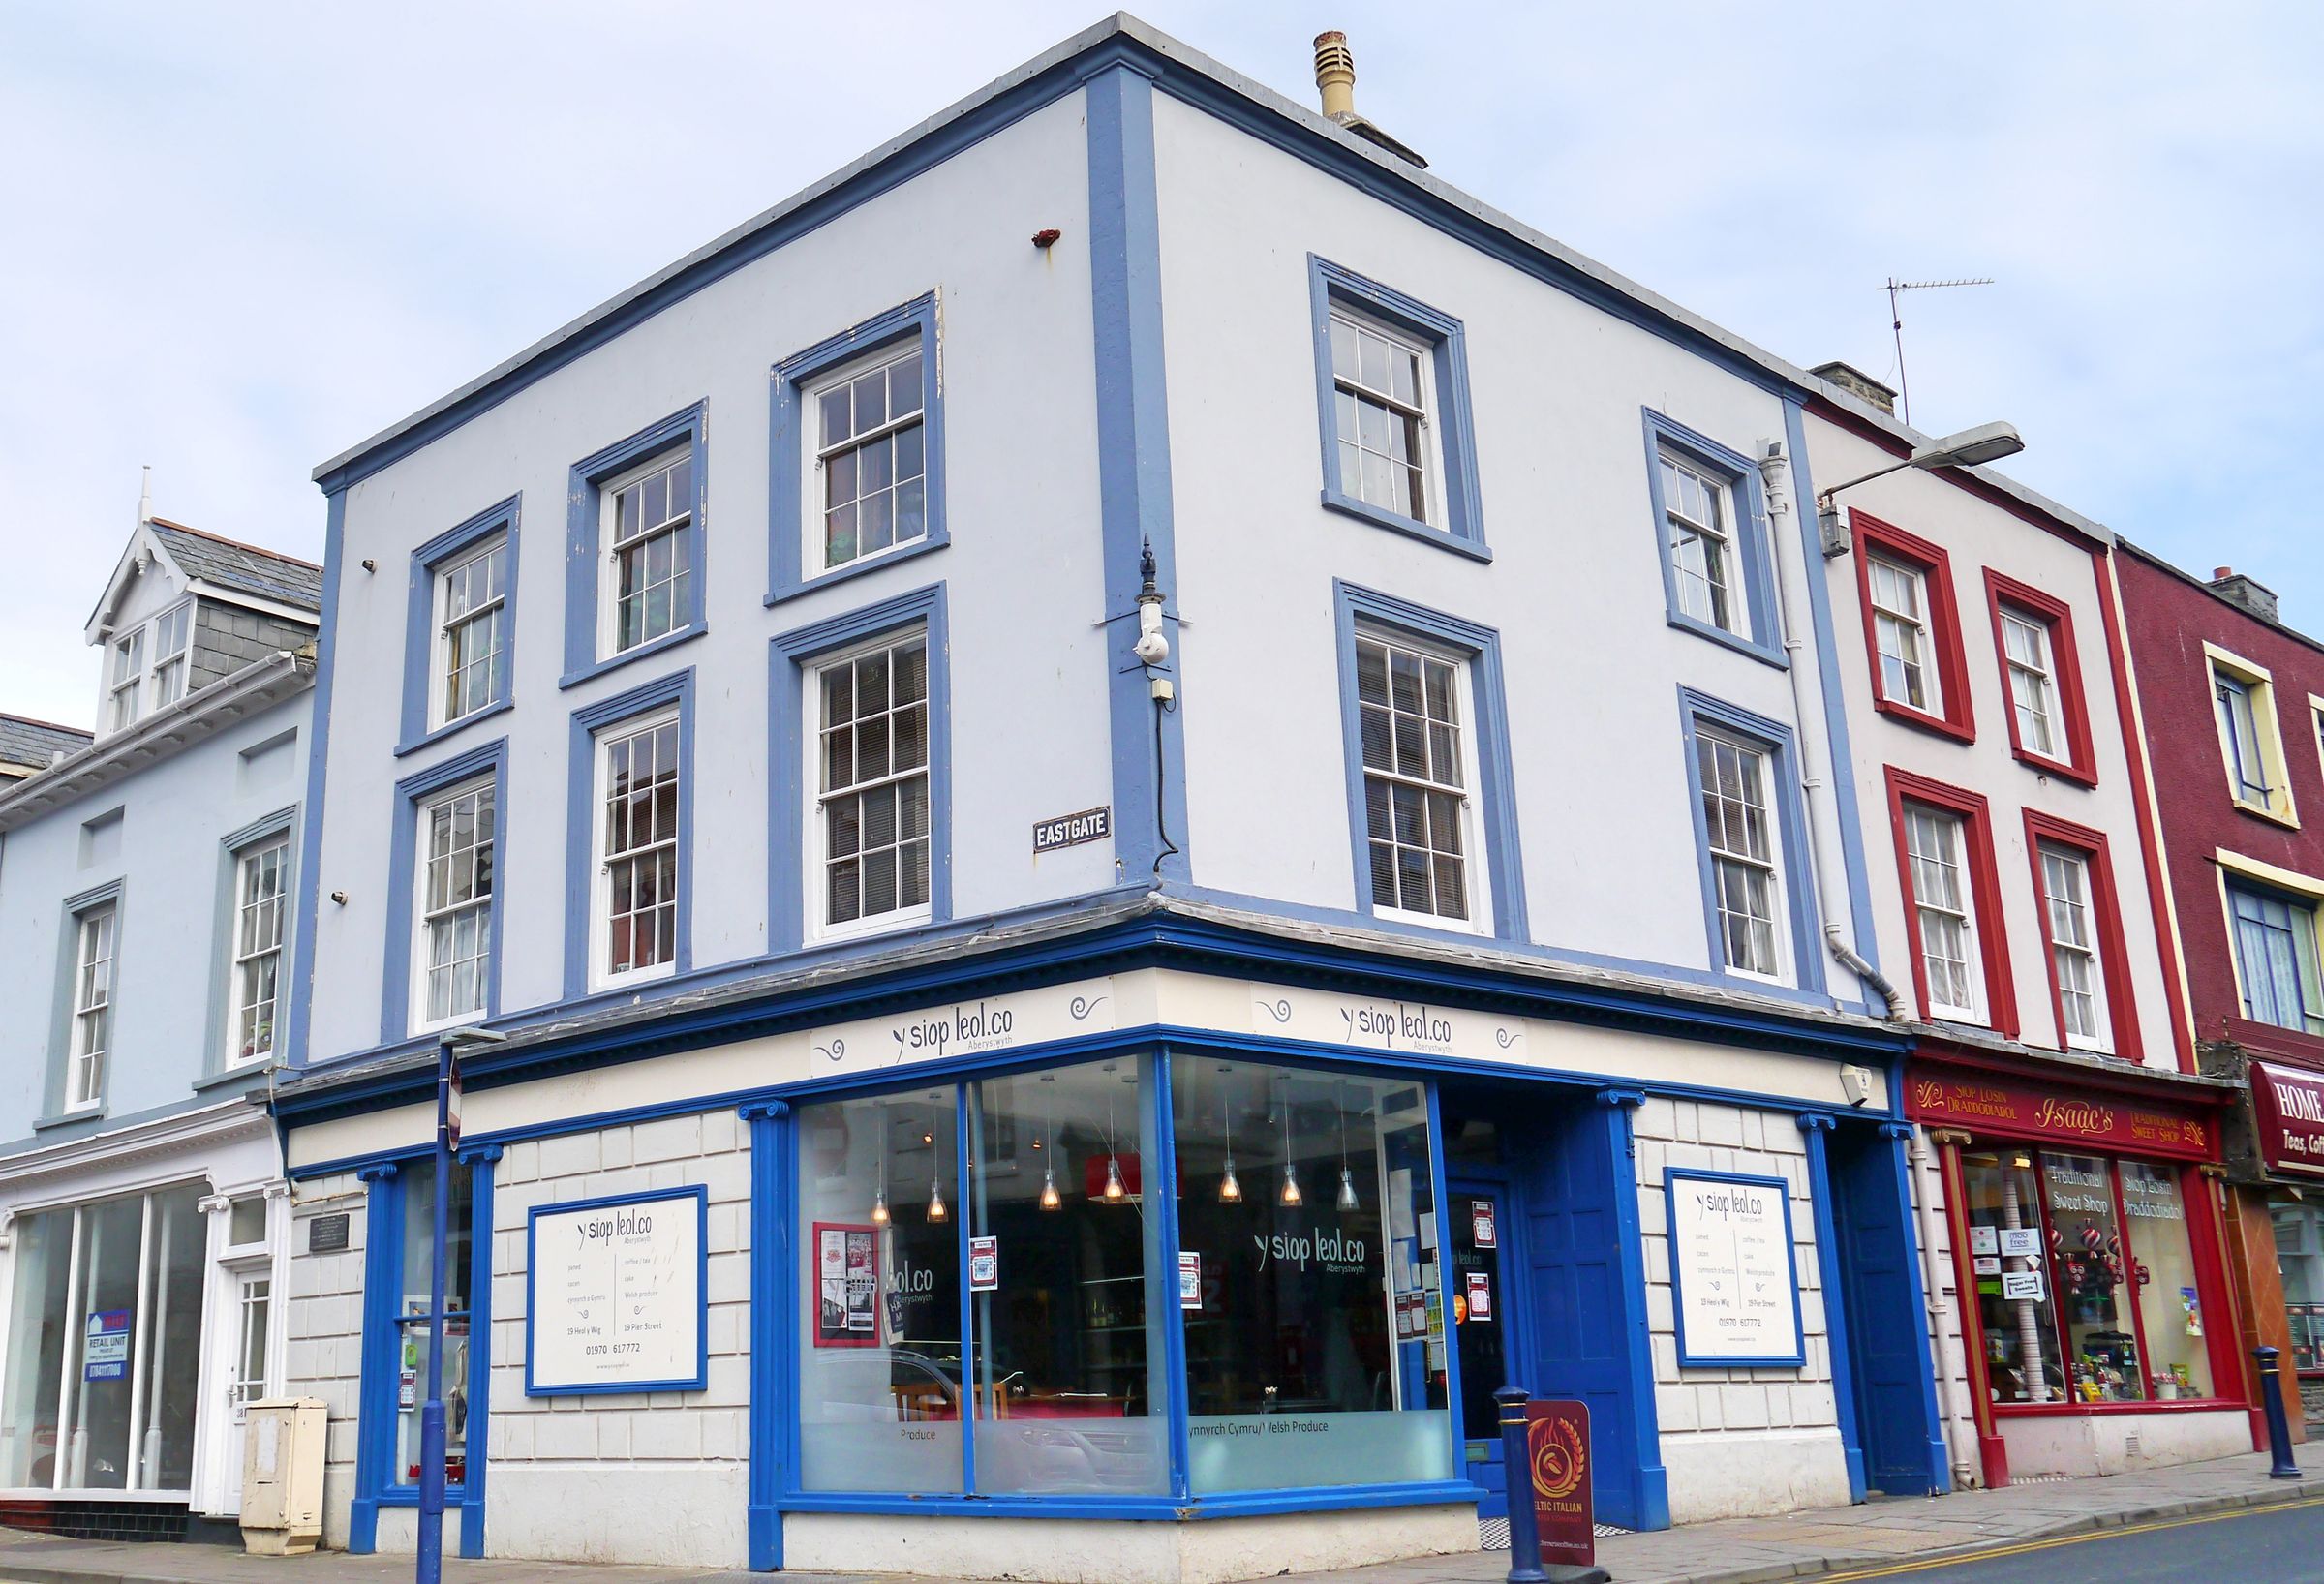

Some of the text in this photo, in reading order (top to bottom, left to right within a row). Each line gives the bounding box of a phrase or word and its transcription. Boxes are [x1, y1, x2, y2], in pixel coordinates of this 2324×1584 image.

[1037, 813, 1106, 846] EASTGATE
[910, 1019, 949, 1056] siop
[956, 1002, 1012, 1041] leol.co
[1359, 1006, 1395, 1048] siop
[1400, 1004, 1451, 1043] leol.co
[967, 1035, 1013, 1051] Aberystwyth
[1413, 1041, 1452, 1054] Aberystwyth
[1956, 1085, 1976, 1099] SIOP
[2034, 1098, 2113, 1134] Isaac's
[2131, 1126, 2180, 1143] SWEET SHOP
[2283, 1129, 2307, 1155] Teas,
[2052, 1165, 2103, 1189] Traditional
[2125, 1176, 2146, 1196] Siop
[1706, 1192, 1729, 1221] siop
[1730, 1188, 1762, 1214] leol.co
[2054, 1191, 2108, 1217] Sweet Shop
[588, 1217, 614, 1246] siop
[616, 1208, 652, 1236] leol.co
[1272, 1231, 1310, 1272] siop
[1315, 1227, 1365, 1263] leol.co
[896, 1260, 933, 1293] ol.co
[1326, 1264, 1365, 1274] Aberystwyth
[591, 1326, 601, 1335] Wig
[631, 1323, 643, 1331] Pier
[644, 1322, 662, 1330] Street
[1719, 1318, 1762, 1327] 01970 617772
[89, 1336, 126, 1348] RETAIL UNIT
[586, 1343, 640, 1355] 01970 617772
[1189, 1423, 1225, 1438] ynnyrch
[1292, 1420, 1329, 1432] Produce
[1553, 1501, 1582, 1513] ITALIAN
